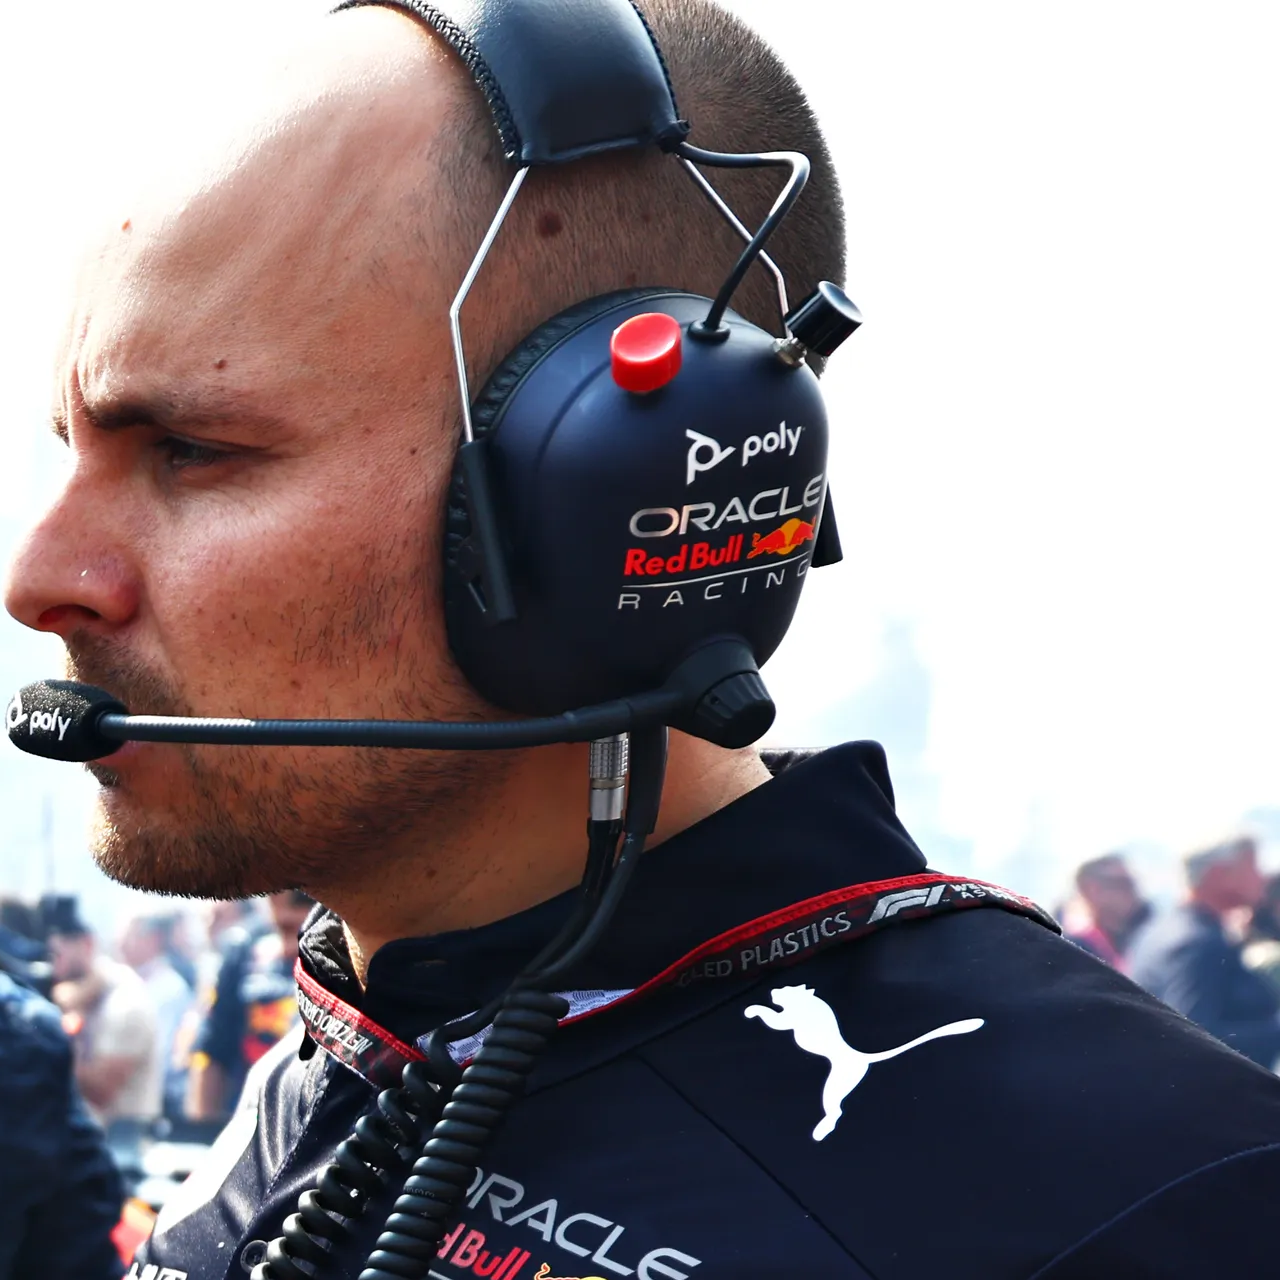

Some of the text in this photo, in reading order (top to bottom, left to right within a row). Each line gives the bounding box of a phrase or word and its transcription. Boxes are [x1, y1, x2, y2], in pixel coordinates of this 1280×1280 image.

[741, 420, 803, 467] poly
[628, 472, 824, 538] ORACLE
[617, 558, 811, 610] RACING
[29, 707, 72, 741] poly
[674, 959, 733, 988] CLED
[740, 911, 852, 971] PLASTICS
